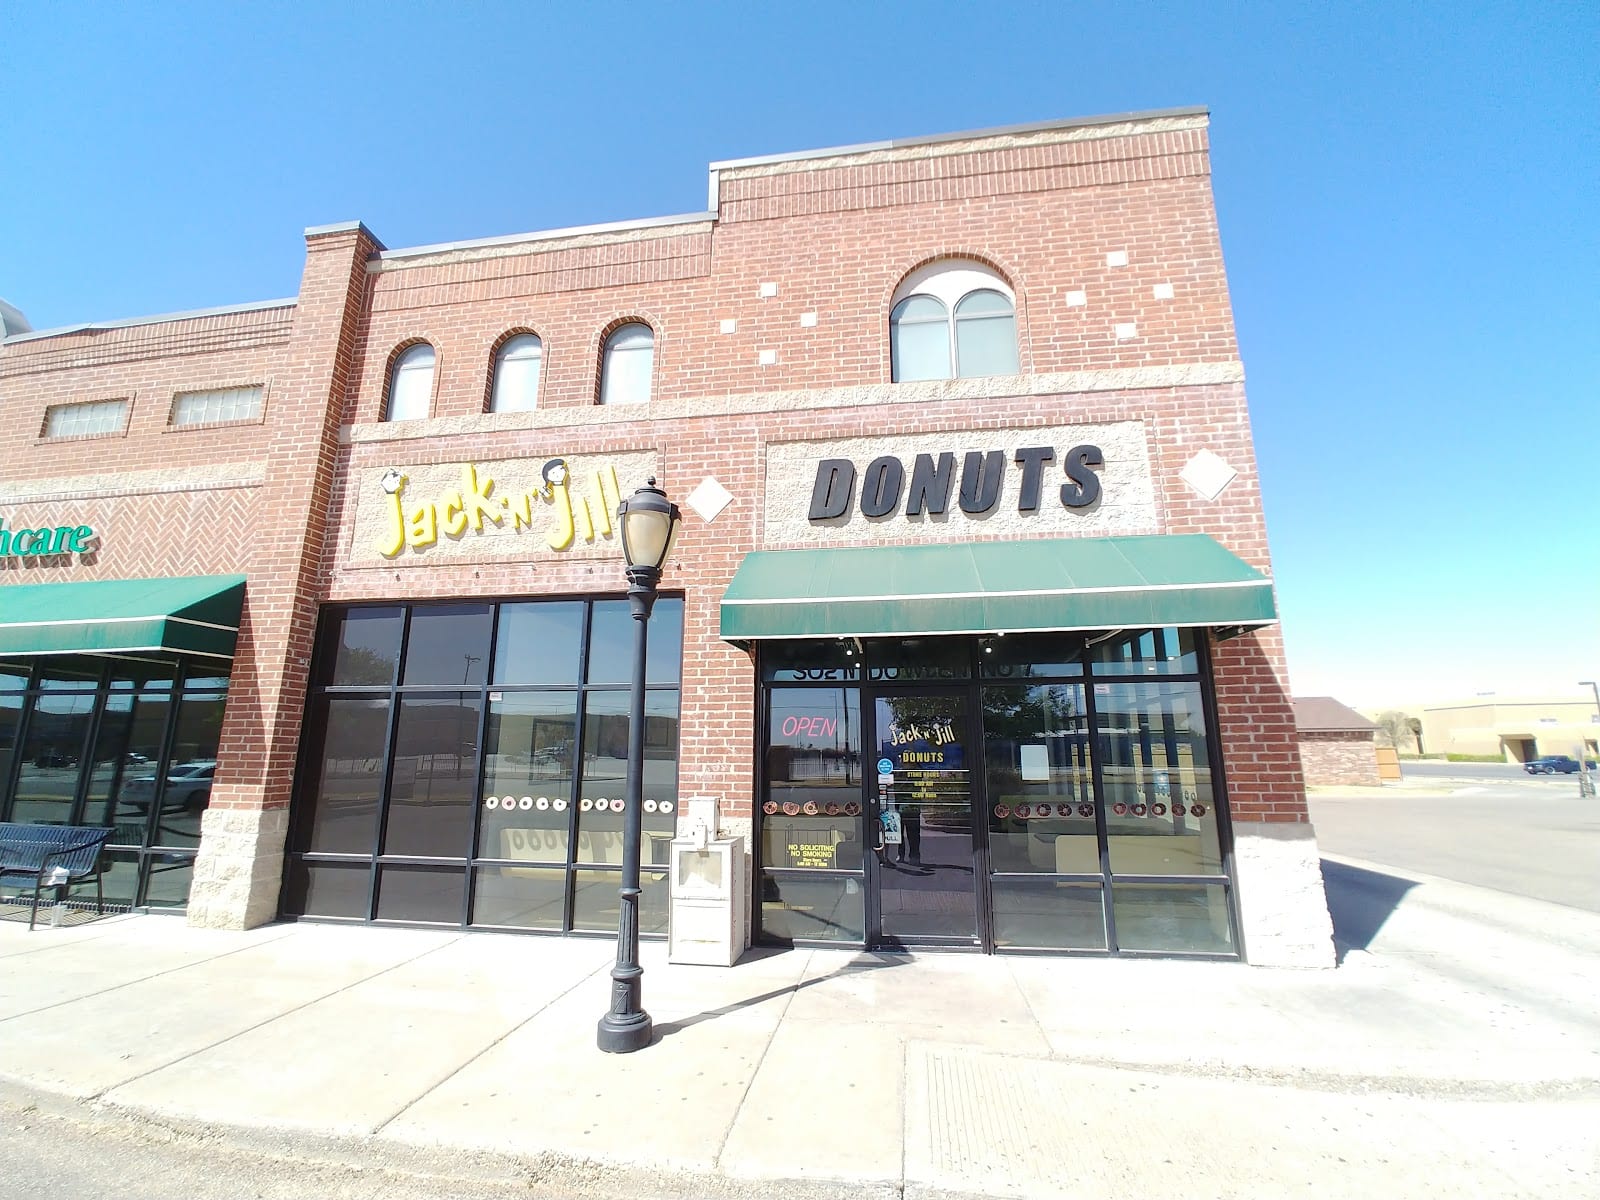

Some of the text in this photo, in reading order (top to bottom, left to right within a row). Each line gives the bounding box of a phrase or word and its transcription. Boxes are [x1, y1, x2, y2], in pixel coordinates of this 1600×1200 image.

[808, 444, 1103, 520] DONUTS
[782, 716, 838, 737] OPEN
[903, 752, 944, 763] DONUTS
[800, 844, 835, 852] SOLICITING
[802, 850, 833, 858] SMOKING
